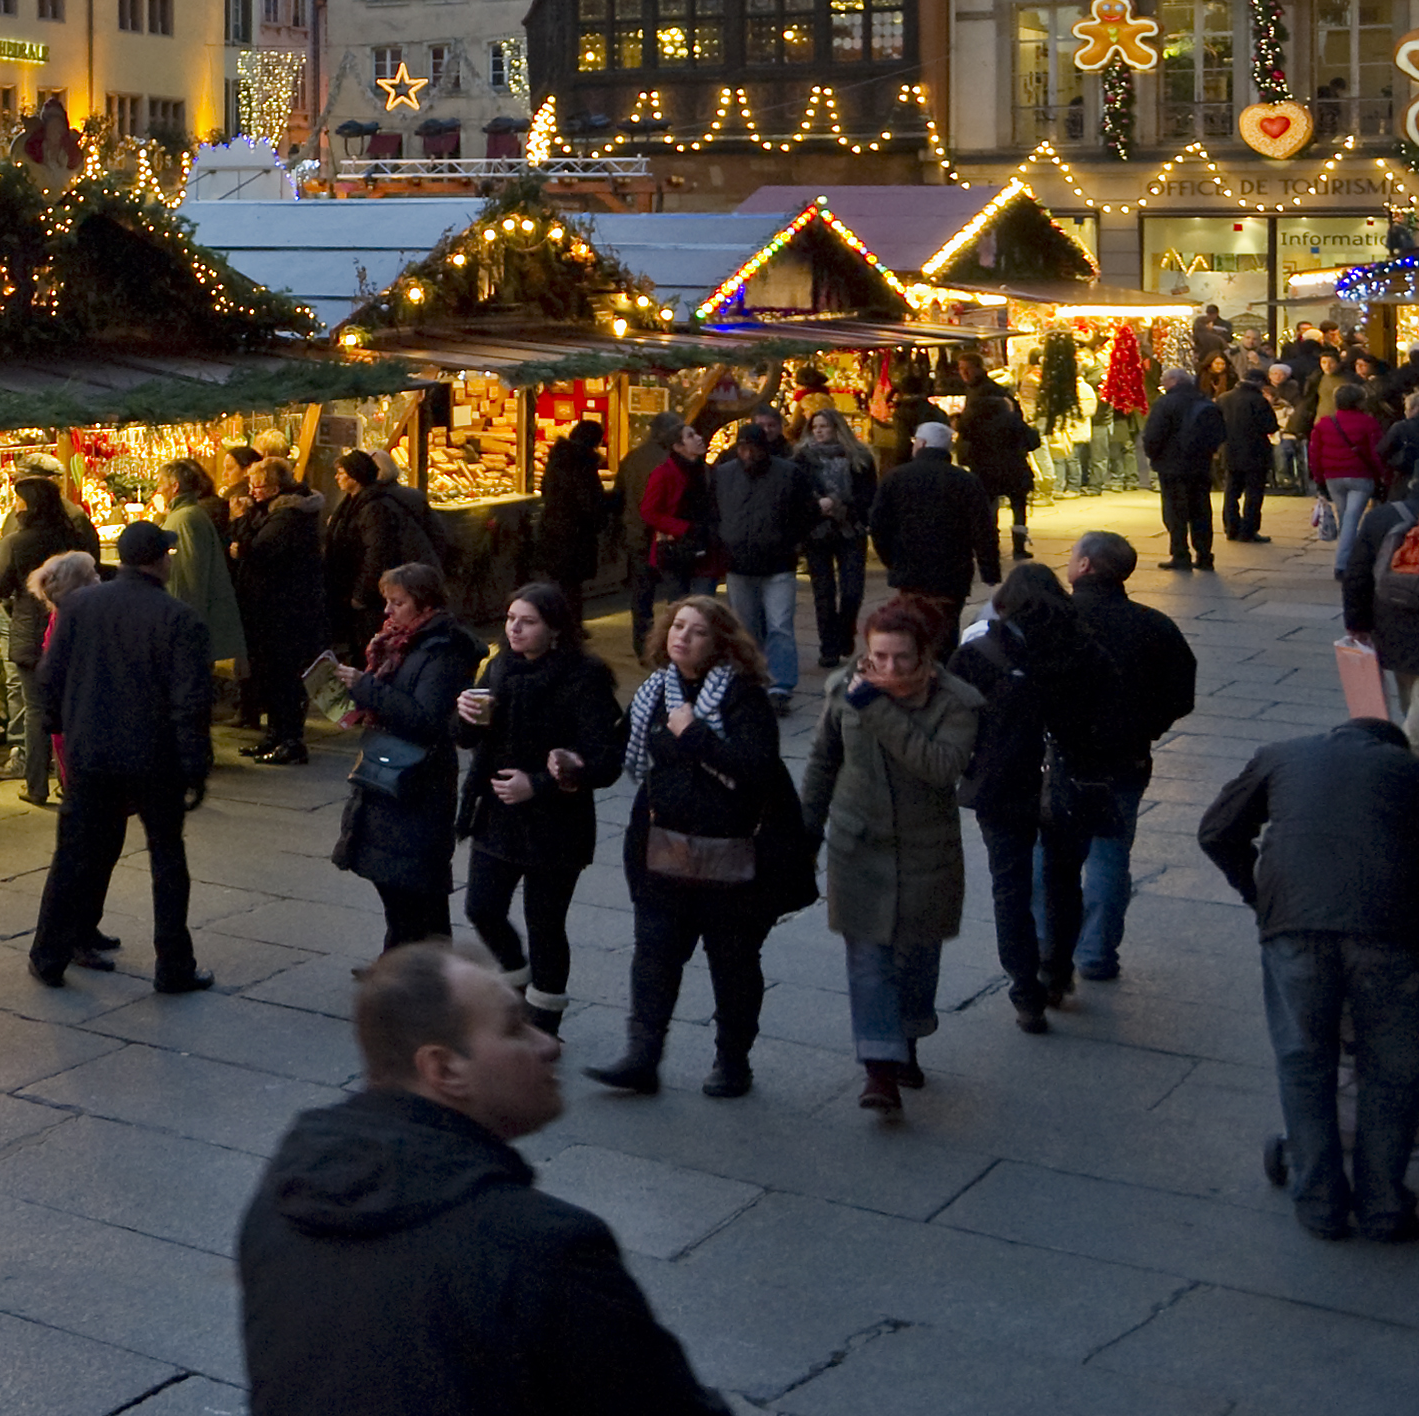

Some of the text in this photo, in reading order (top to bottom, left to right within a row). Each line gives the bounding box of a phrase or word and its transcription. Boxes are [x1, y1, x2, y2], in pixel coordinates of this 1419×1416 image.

[1146, 178, 1404, 196] OFFICE DE TOURISME
